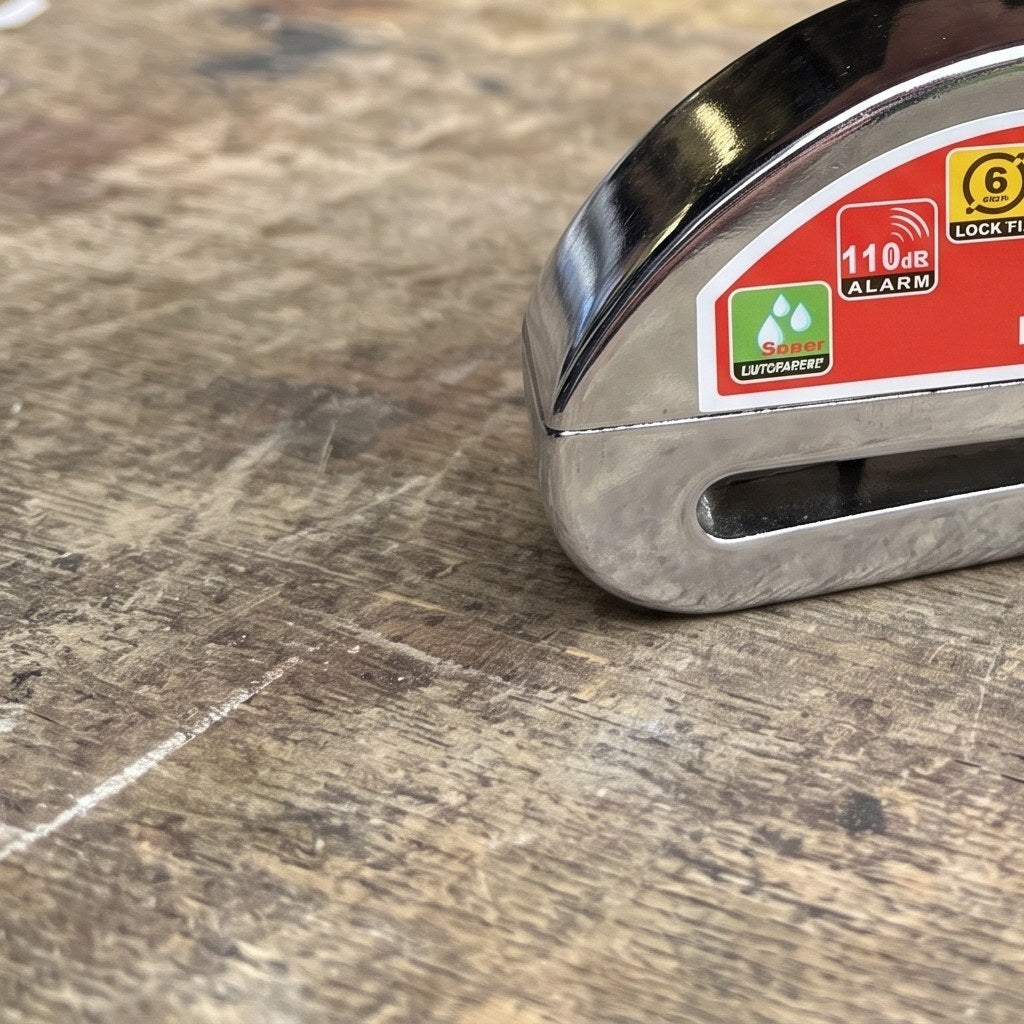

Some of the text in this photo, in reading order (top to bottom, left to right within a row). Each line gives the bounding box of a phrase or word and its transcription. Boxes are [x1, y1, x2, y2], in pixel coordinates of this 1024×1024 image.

[985, 166, 1008, 194] 6
[955, 222, 1002, 238] LOCK
[847, 274, 930, 295] ALARM
